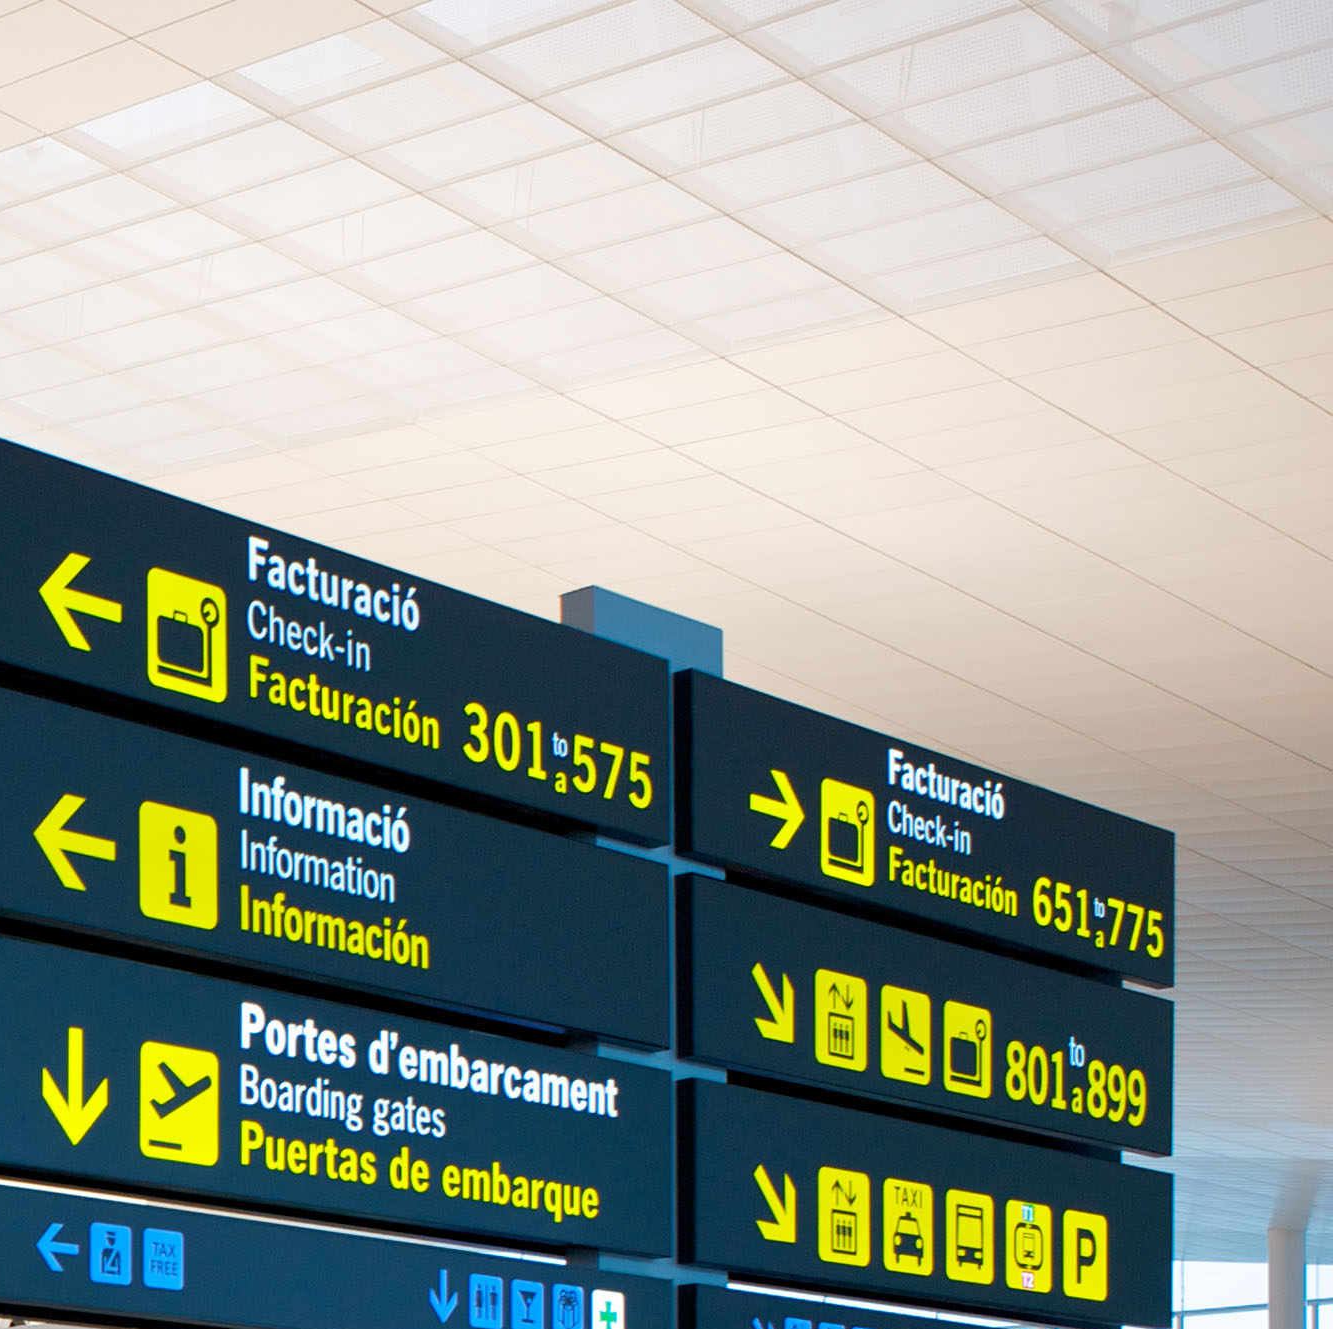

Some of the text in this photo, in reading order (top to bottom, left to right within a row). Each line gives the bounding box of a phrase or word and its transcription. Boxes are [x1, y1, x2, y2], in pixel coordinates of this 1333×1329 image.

[247, 536, 420, 631] Facturació
[247, 601, 371, 672] Check-in
[249, 655, 653, 808] Facturación 301 to a 575
[239, 767, 410, 852] Informació
[887, 748, 1005, 820] Facturació
[887, 800, 971, 856] Check-in
[241, 830, 396, 904] Information
[888, 845, 1018, 918] Facturación
[1033, 876, 1090, 939] 651
[1093, 897, 1105, 919] to
[1108, 897, 1164, 959] 775
[241, 885, 430, 970] Información
[241, 1002, 357, 1068] Portes
[241, 1065, 446, 1140] Boarding gates
[1006, 1040, 1067, 1111] 801
[1068, 1035, 1085, 1068] to
[1087, 1059, 1147, 1127] 899
[241, 1121, 599, 1224] Puertas de embarque
[894, 1185, 924, 1209] TAXI
[1022, 1204, 1035, 1222] T1
[150, 1259, 178, 1277] FREE
[151, 1242, 176, 1258] TAX
[1022, 1272, 1035, 1289] T2
[1076, 1228, 1097, 1285] P
